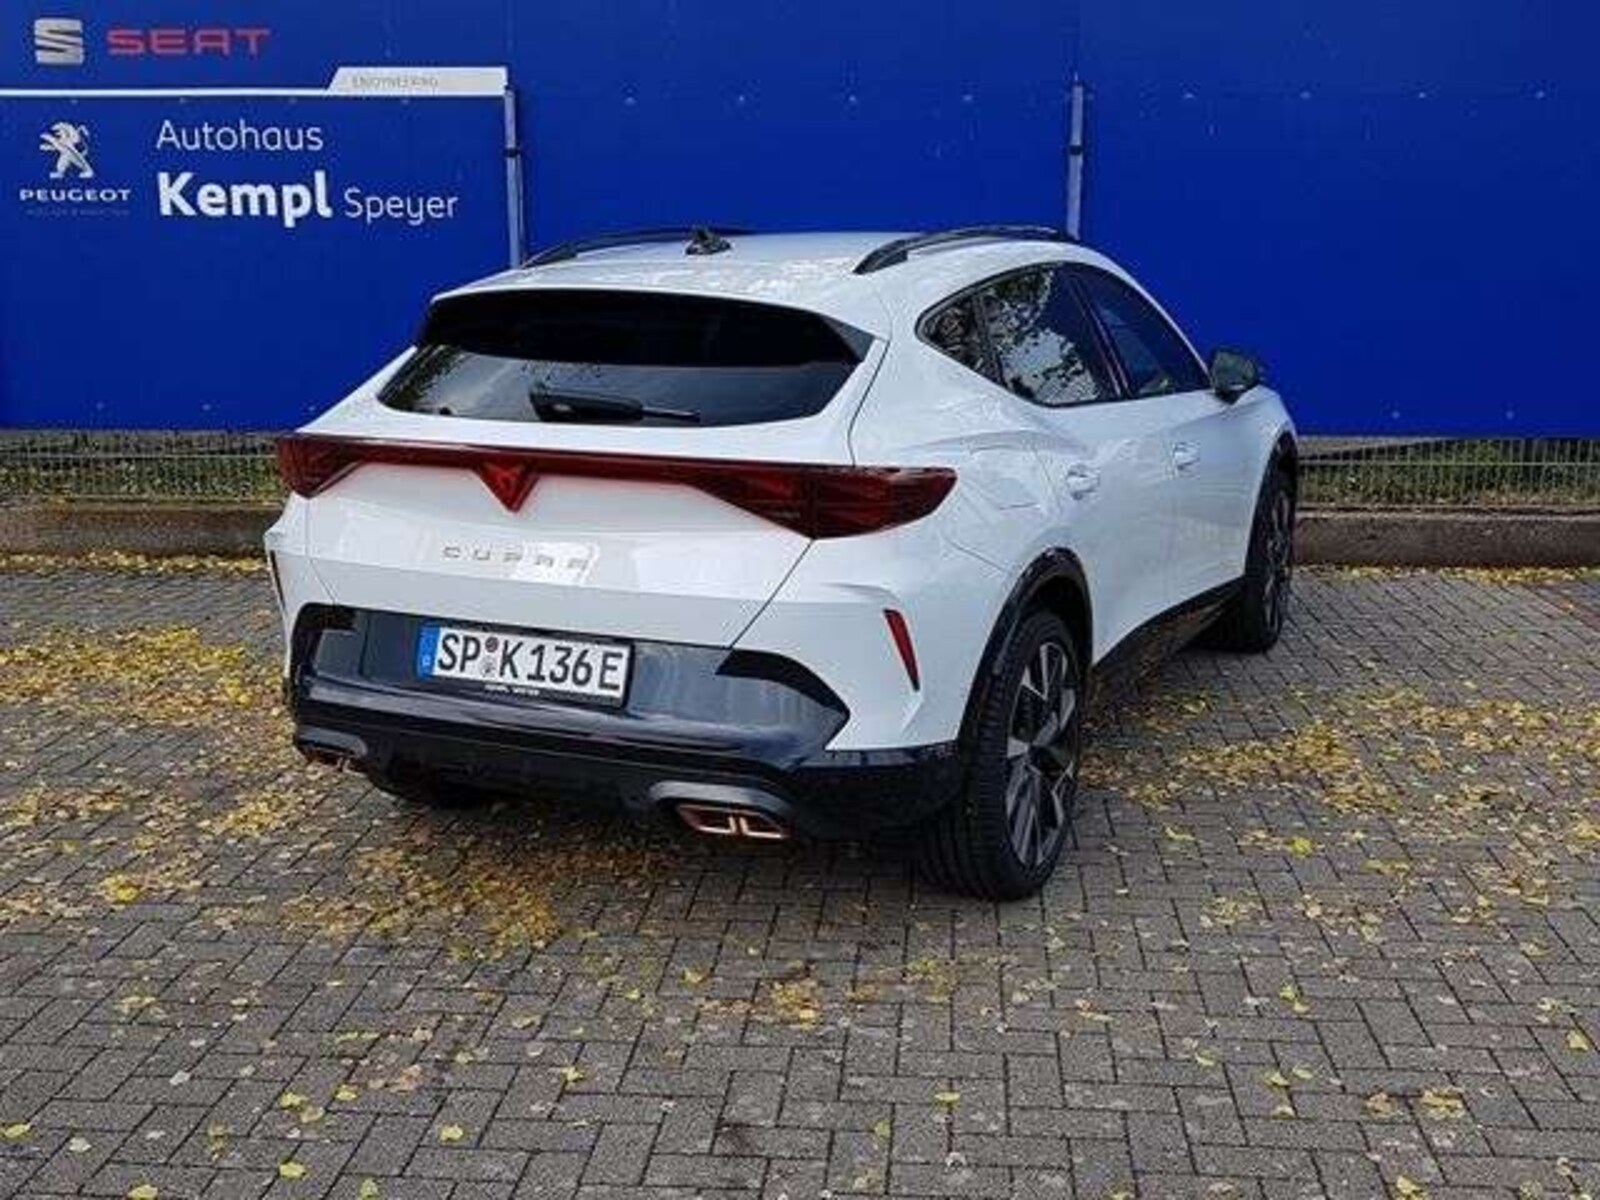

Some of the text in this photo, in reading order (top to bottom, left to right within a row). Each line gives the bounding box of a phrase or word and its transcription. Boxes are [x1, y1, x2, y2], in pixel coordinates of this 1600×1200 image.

[107, 28, 271, 56] SEAT
[156, 119, 325, 151] Autohaus
[20, 189, 131, 201] PEUGEOT
[157, 170, 458, 228] Kempl Speyer
[438, 633, 481, 673] SP
